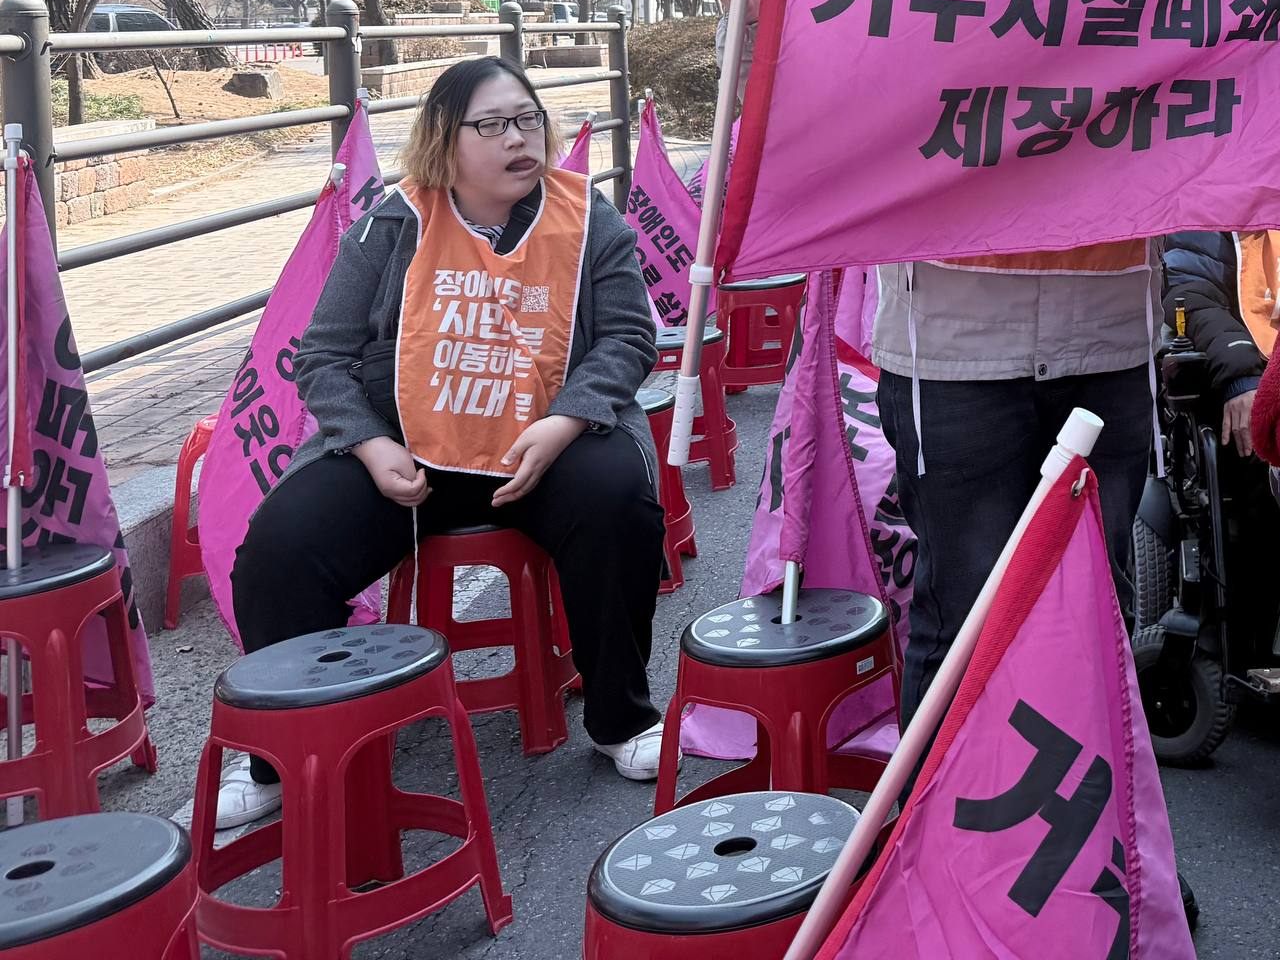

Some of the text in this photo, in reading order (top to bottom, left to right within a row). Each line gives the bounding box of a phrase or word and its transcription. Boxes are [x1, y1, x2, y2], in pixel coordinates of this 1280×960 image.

[919, 77, 1242, 167] 제정하라
[628, 184, 695, 273] 장애인도
[433, 269, 522, 309] 장애도
[952, 698, 1131, 960] 거
